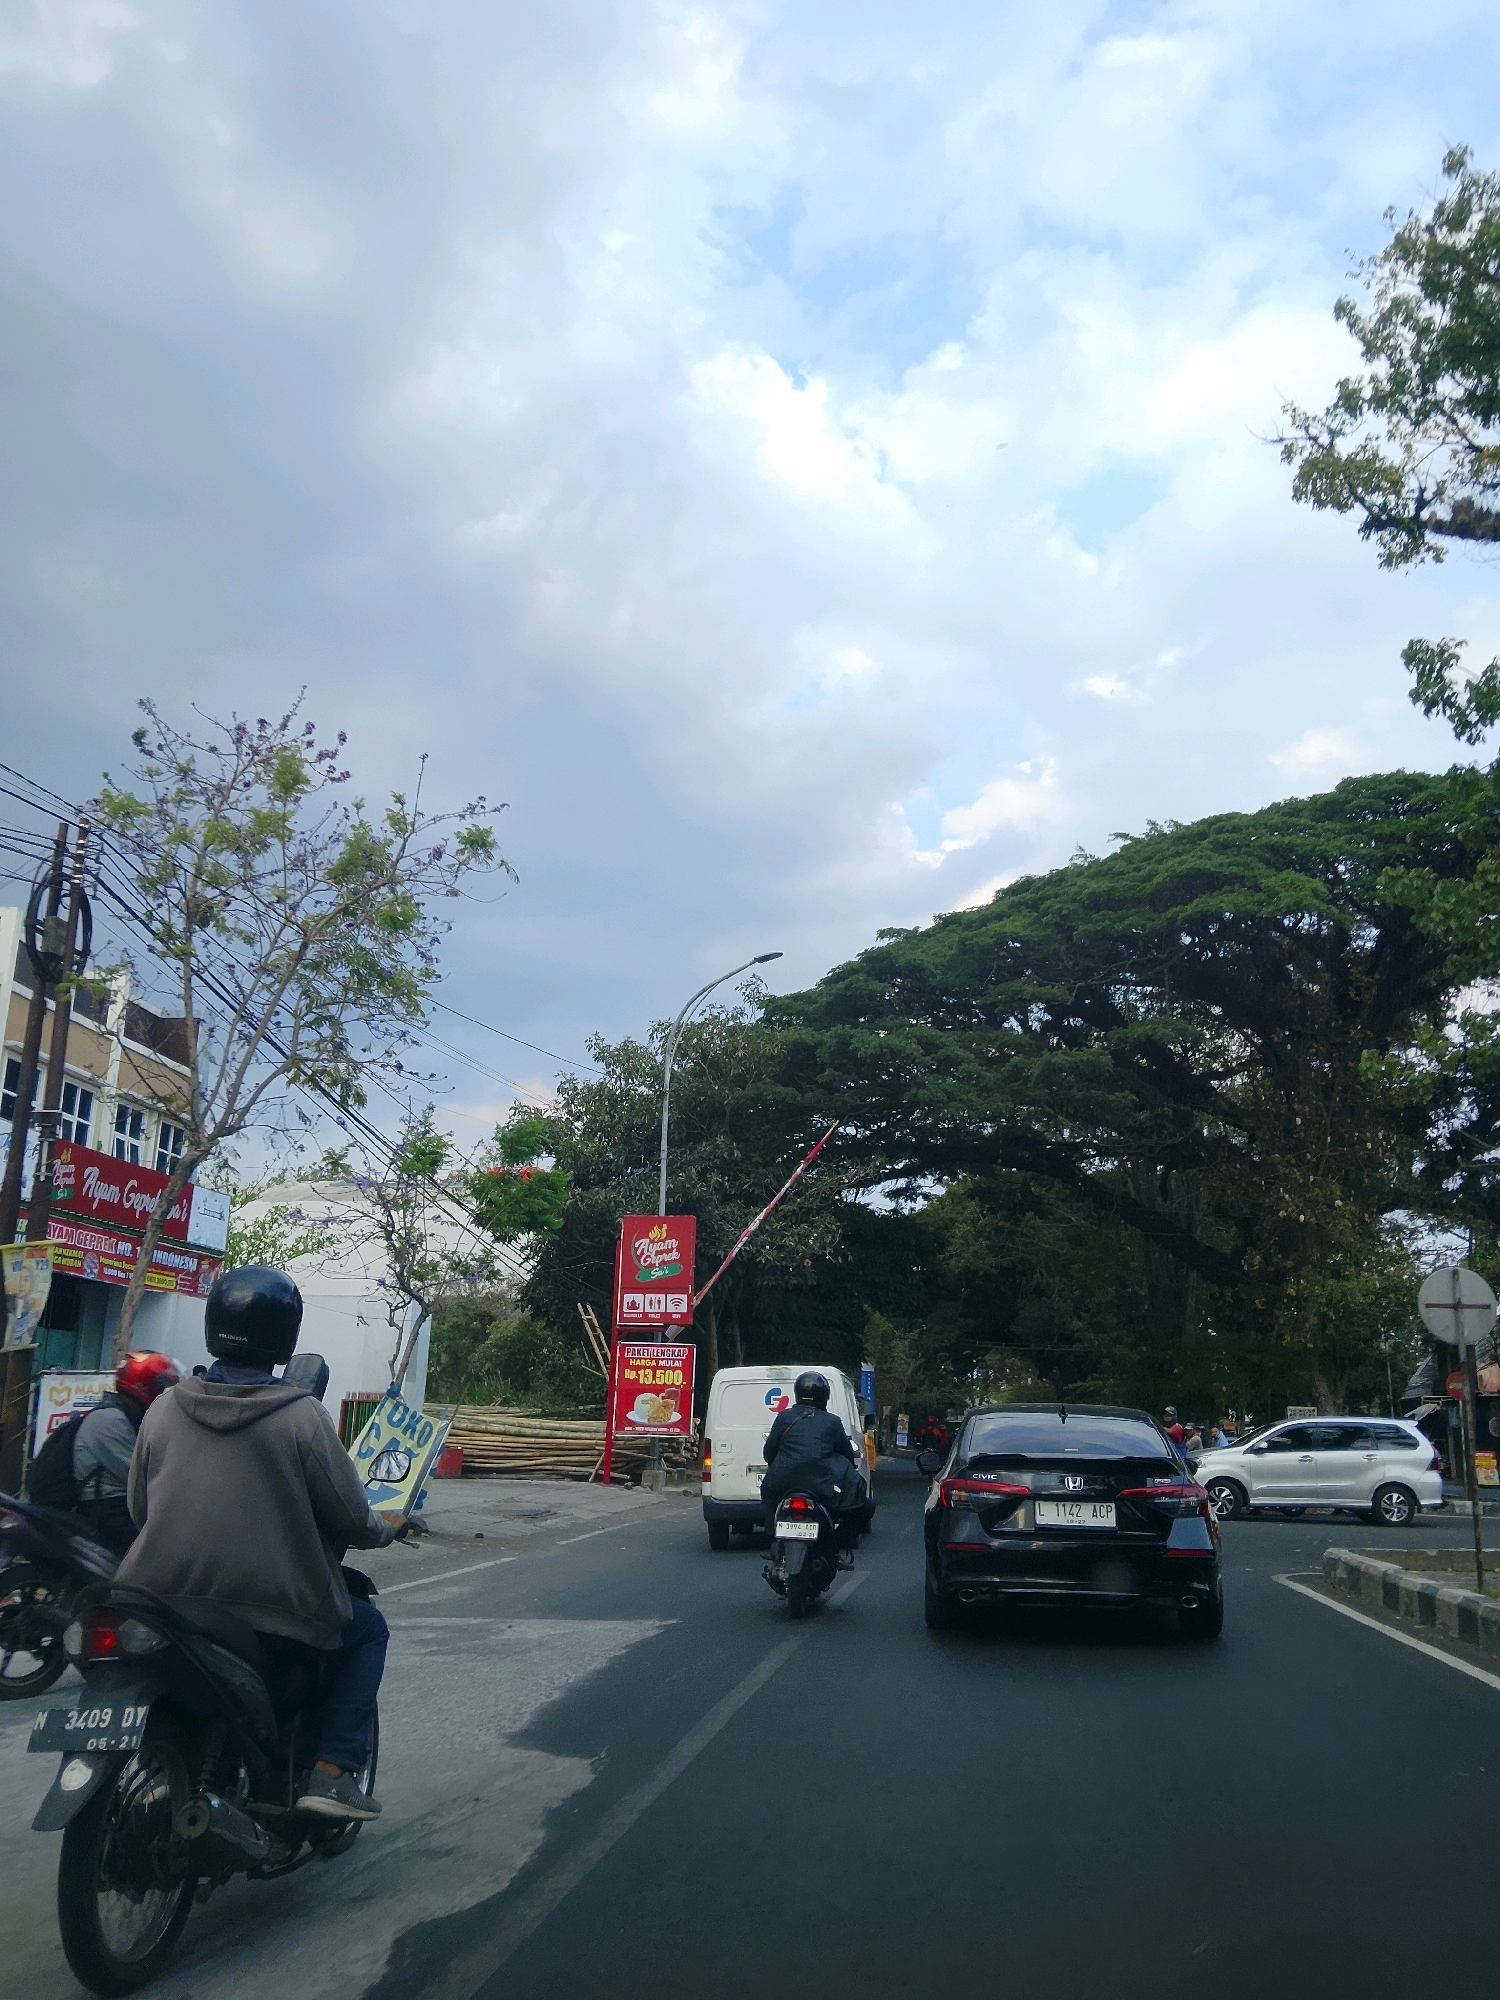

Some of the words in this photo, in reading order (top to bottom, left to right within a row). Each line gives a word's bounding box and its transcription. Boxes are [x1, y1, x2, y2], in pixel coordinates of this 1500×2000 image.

[82, 1166, 121, 1210] Ayam
[76, 1229, 118, 1255] GEPREK
[635, 1238, 679, 1256] Ayam
[640, 1248, 680, 1267] Geprek
[625, 1346, 651, 1358] PAKET
[651, 1347, 689, 1360] LENGKAP
[629, 1358, 657, 1367] HARGA
[658, 1359, 683, 1368] MULAI
[1038, 1503, 1045, 1517] L
[1055, 1503, 1083, 1518] 1142
[1092, 1504, 1113, 1519] ACP
[34, 1711, 48, 1730] N
[65, 1708, 113, 1730] 3409
[121, 1706, 148, 1728] DY
